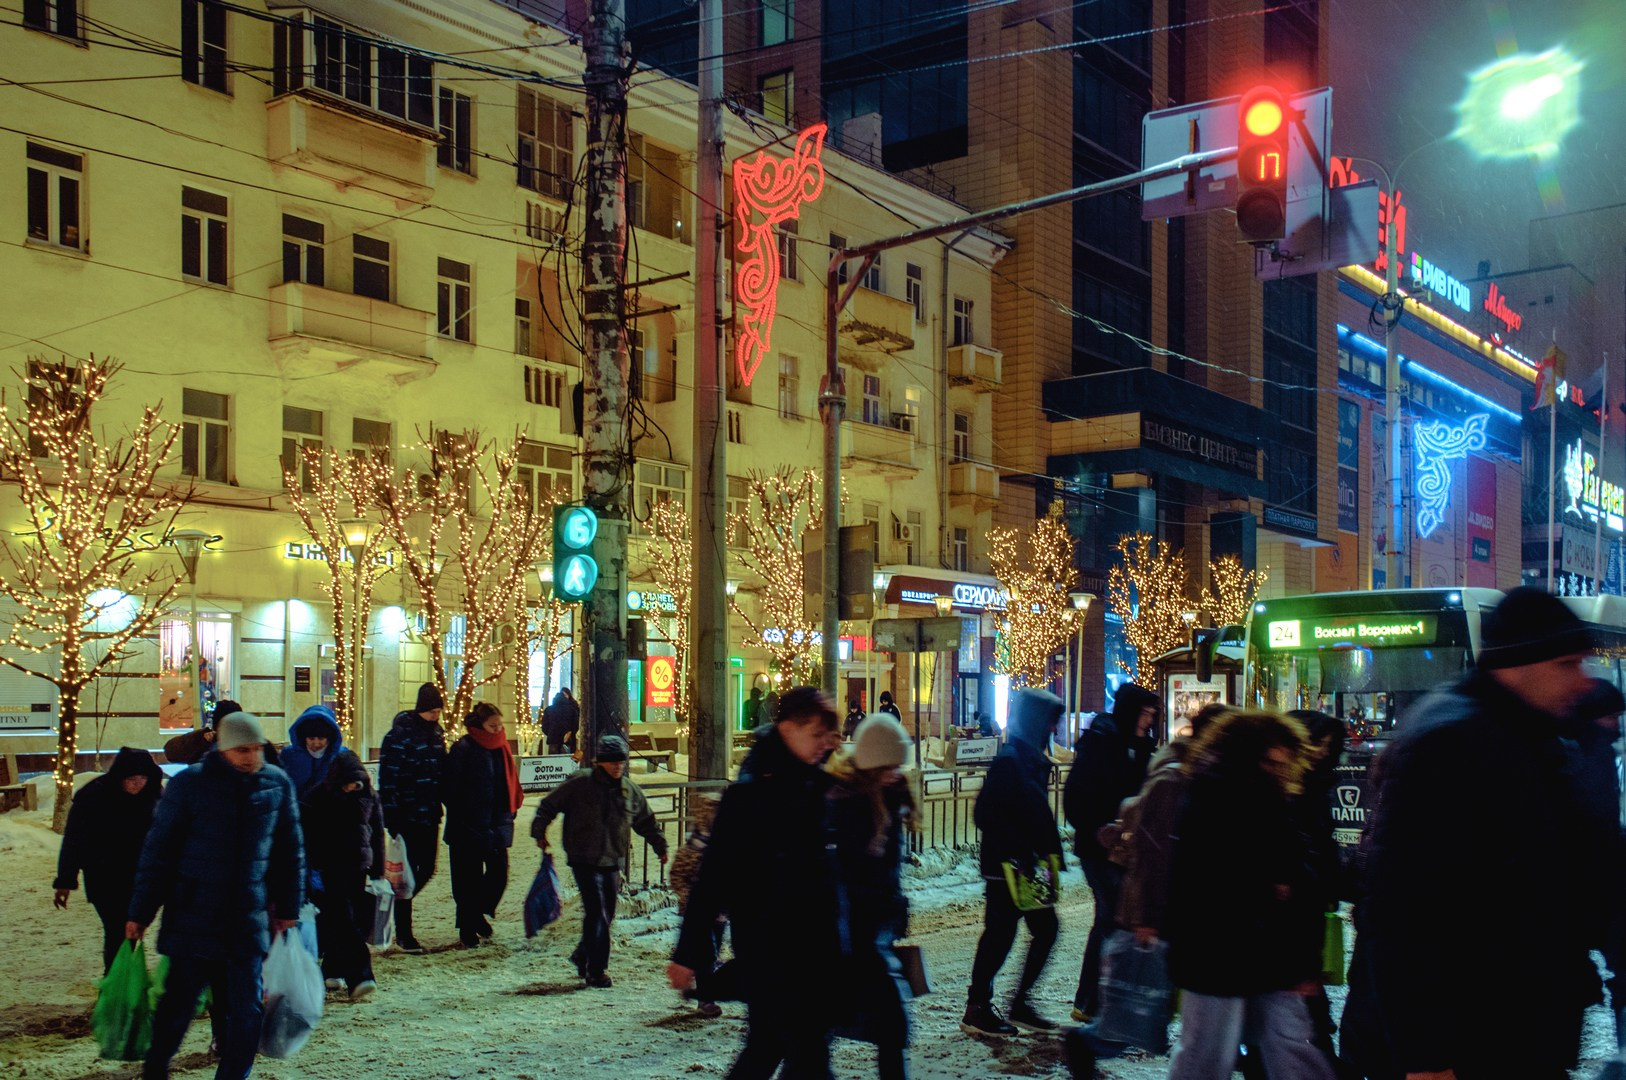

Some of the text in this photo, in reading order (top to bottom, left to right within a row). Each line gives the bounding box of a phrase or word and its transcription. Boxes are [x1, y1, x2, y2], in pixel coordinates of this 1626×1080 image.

[1259, 153, 1280, 179] 17
[1423, 258, 1447, 301] РИВ
[1447, 276, 1470, 313] ГОШ
[1144, 420, 1197, 452] БИЗНЕС
[1199, 436, 1238, 465] ЦЕНТР
[569, 514, 590, 544] 6
[1274, 625, 1293, 642] 24
[1314, 620, 1424, 638] Вокзал Воронеж-1
[534, 765, 554, 773] ФОТО
[1332, 807, 1365, 821] ПАТП
